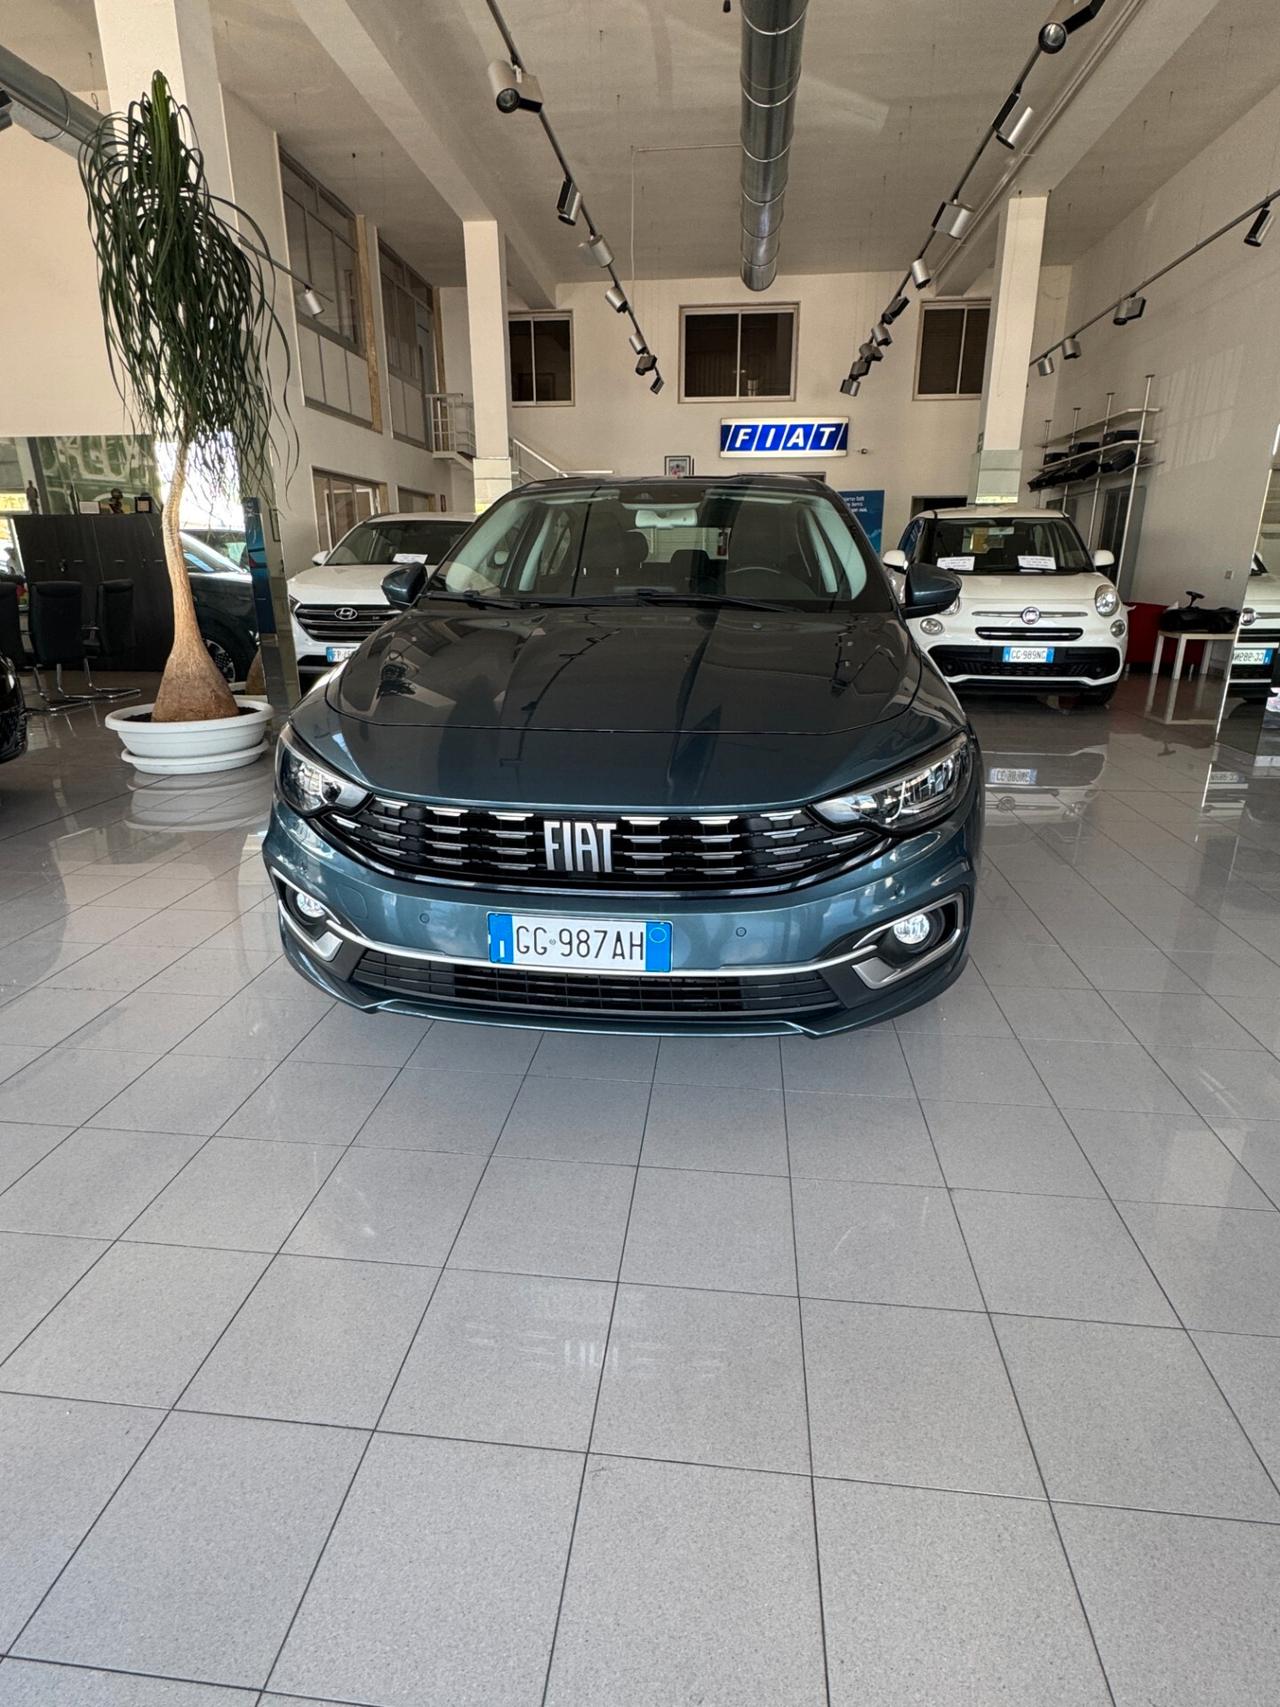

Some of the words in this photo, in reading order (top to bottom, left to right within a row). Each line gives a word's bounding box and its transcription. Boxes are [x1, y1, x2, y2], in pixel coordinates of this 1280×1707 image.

[735, 427, 836, 448] FIAT
[543, 820, 617, 873] FIAT
[558, 928, 645, 961] 987AH
